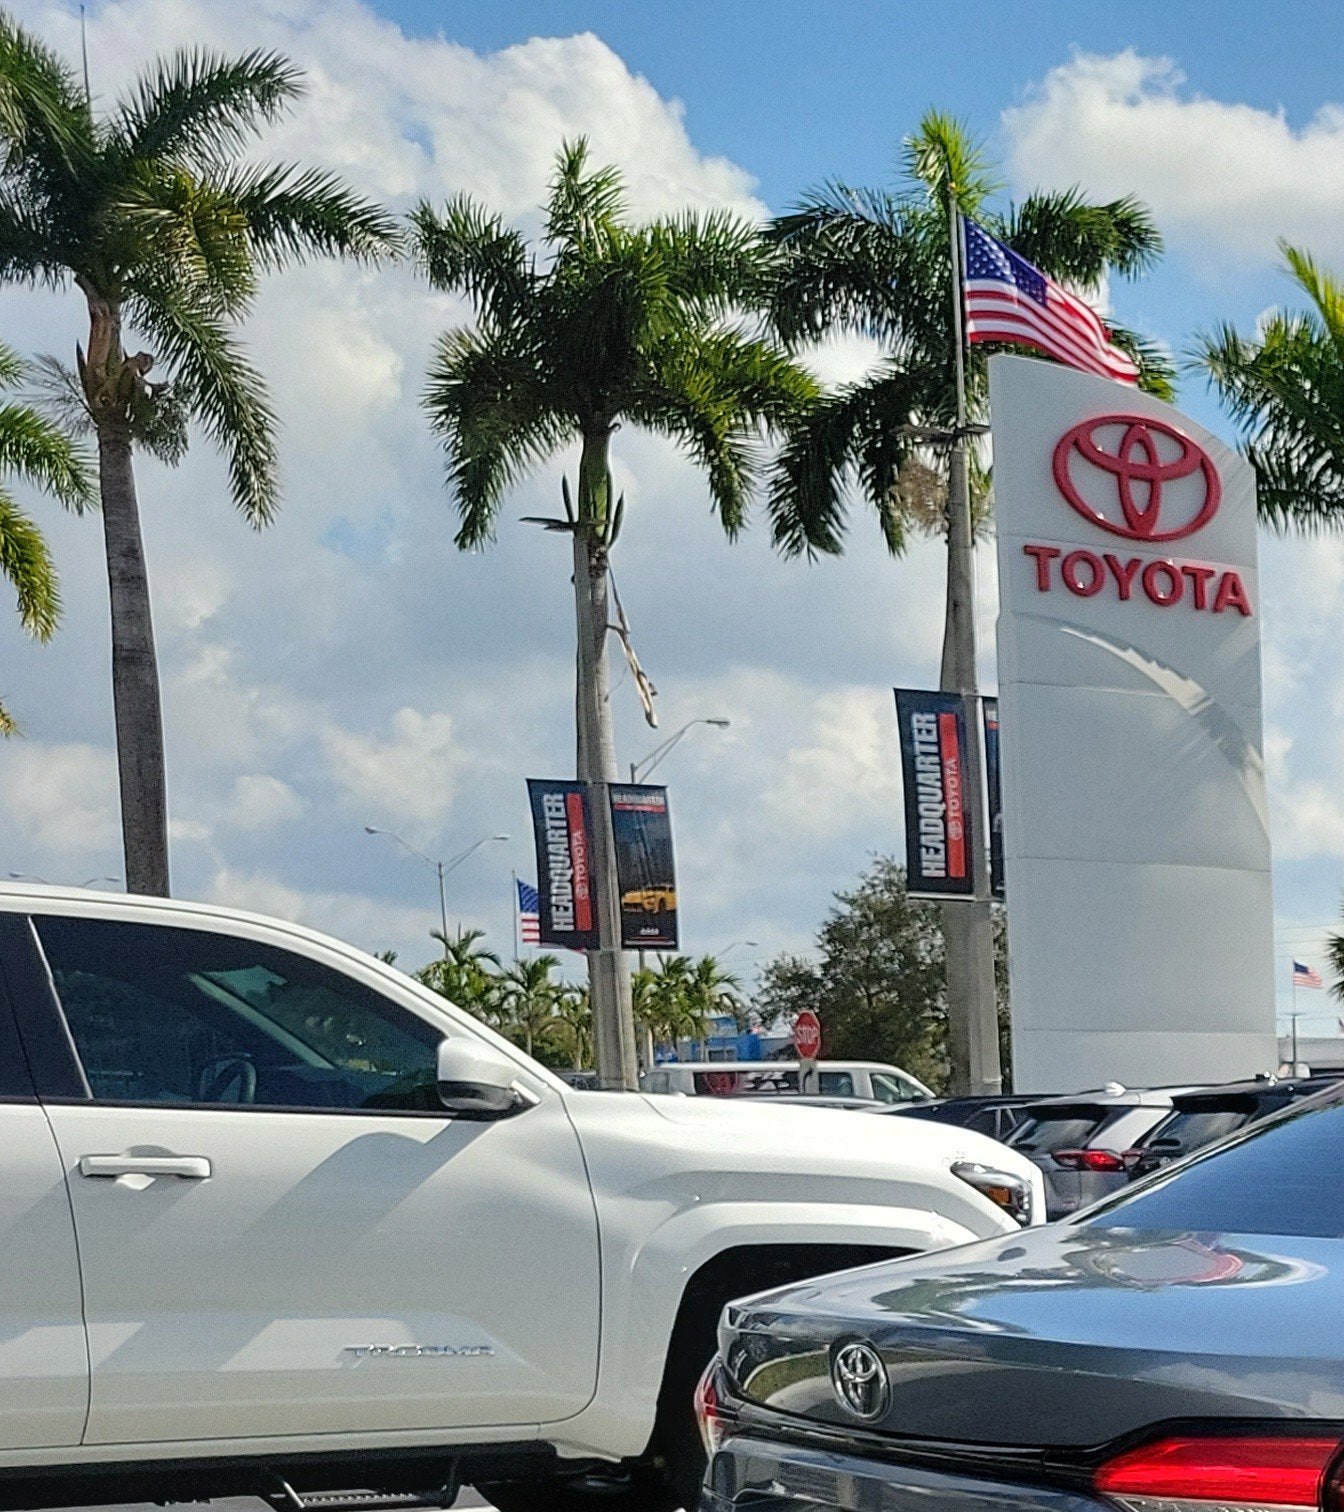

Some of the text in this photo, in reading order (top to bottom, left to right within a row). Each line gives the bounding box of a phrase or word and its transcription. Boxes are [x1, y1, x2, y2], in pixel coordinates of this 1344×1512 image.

[1023, 544, 1253, 617] TOYOTA
[911, 712, 947, 877] HEADQUARTER
[944, 758, 961, 817] TOYOTA
[543, 793, 575, 931] HEADQUARTER
[572, 832, 588, 882] TOYOTA
[795, 1025, 819, 1044] STOP
